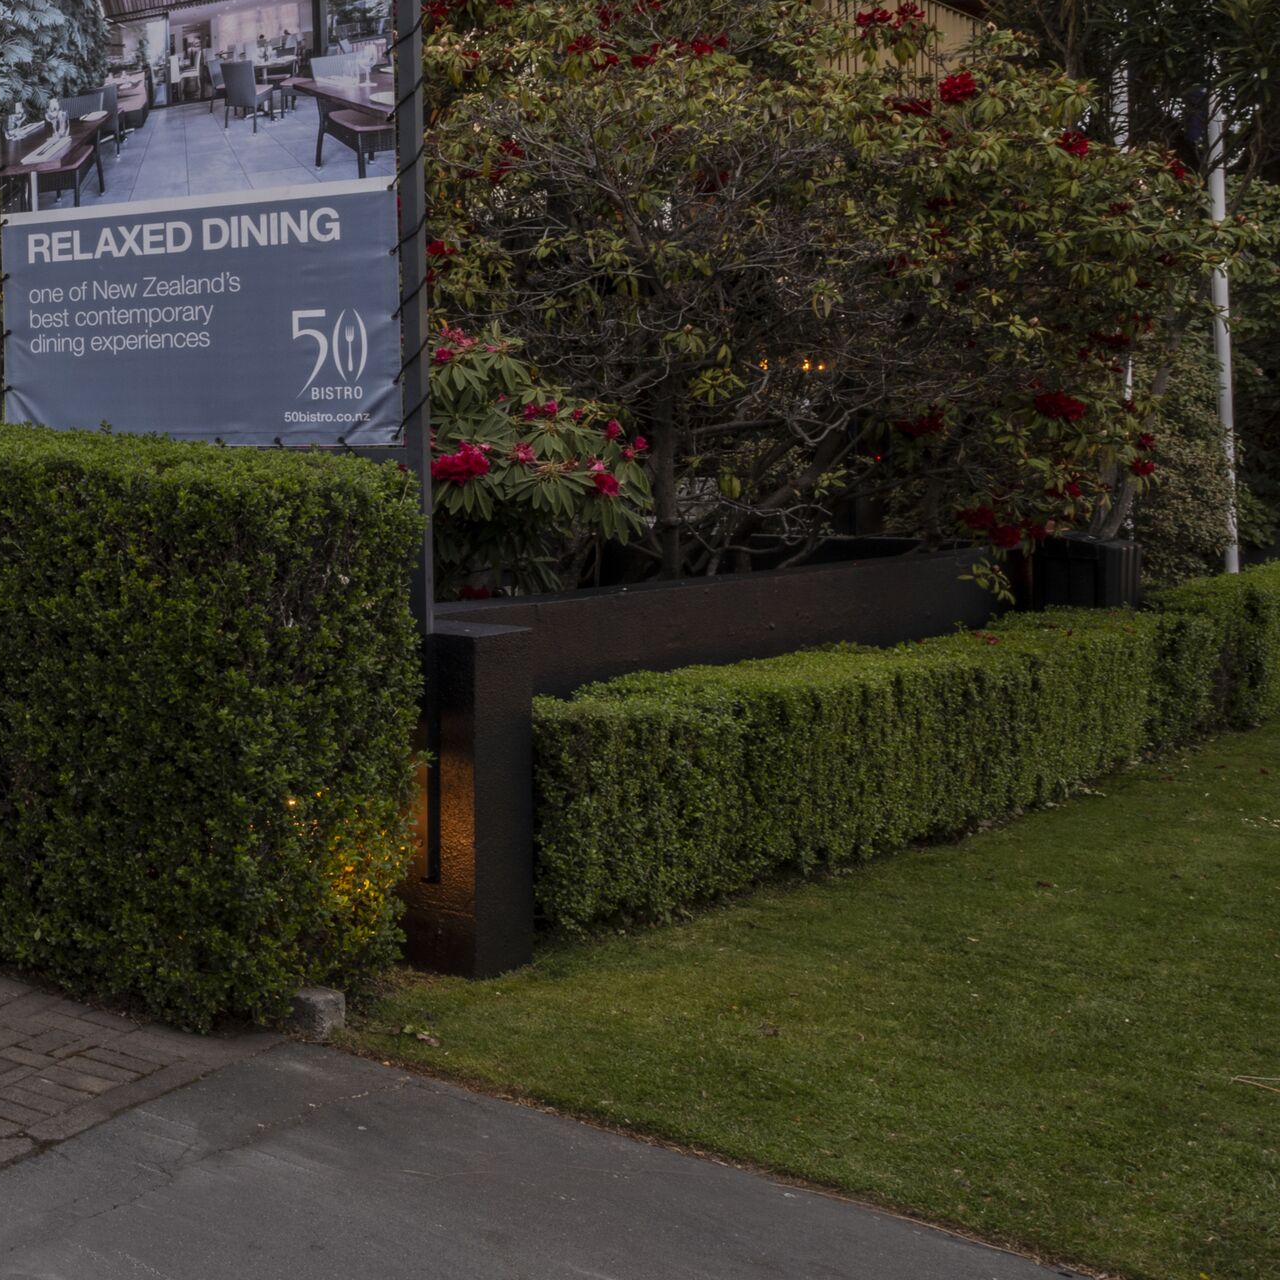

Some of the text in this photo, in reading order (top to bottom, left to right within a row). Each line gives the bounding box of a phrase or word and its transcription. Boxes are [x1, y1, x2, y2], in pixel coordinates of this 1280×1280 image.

[27, 207, 341, 264] RELAXED DINING
[28, 287, 64, 304] one
[68, 281, 88, 302] of
[92, 280, 138, 301] New
[29, 304, 214, 329] best contemporary
[30, 329, 211, 357] dining experiences
[311, 386, 364, 401] BISTRO
[283, 411, 371, 423] 50bistro.co.nz
